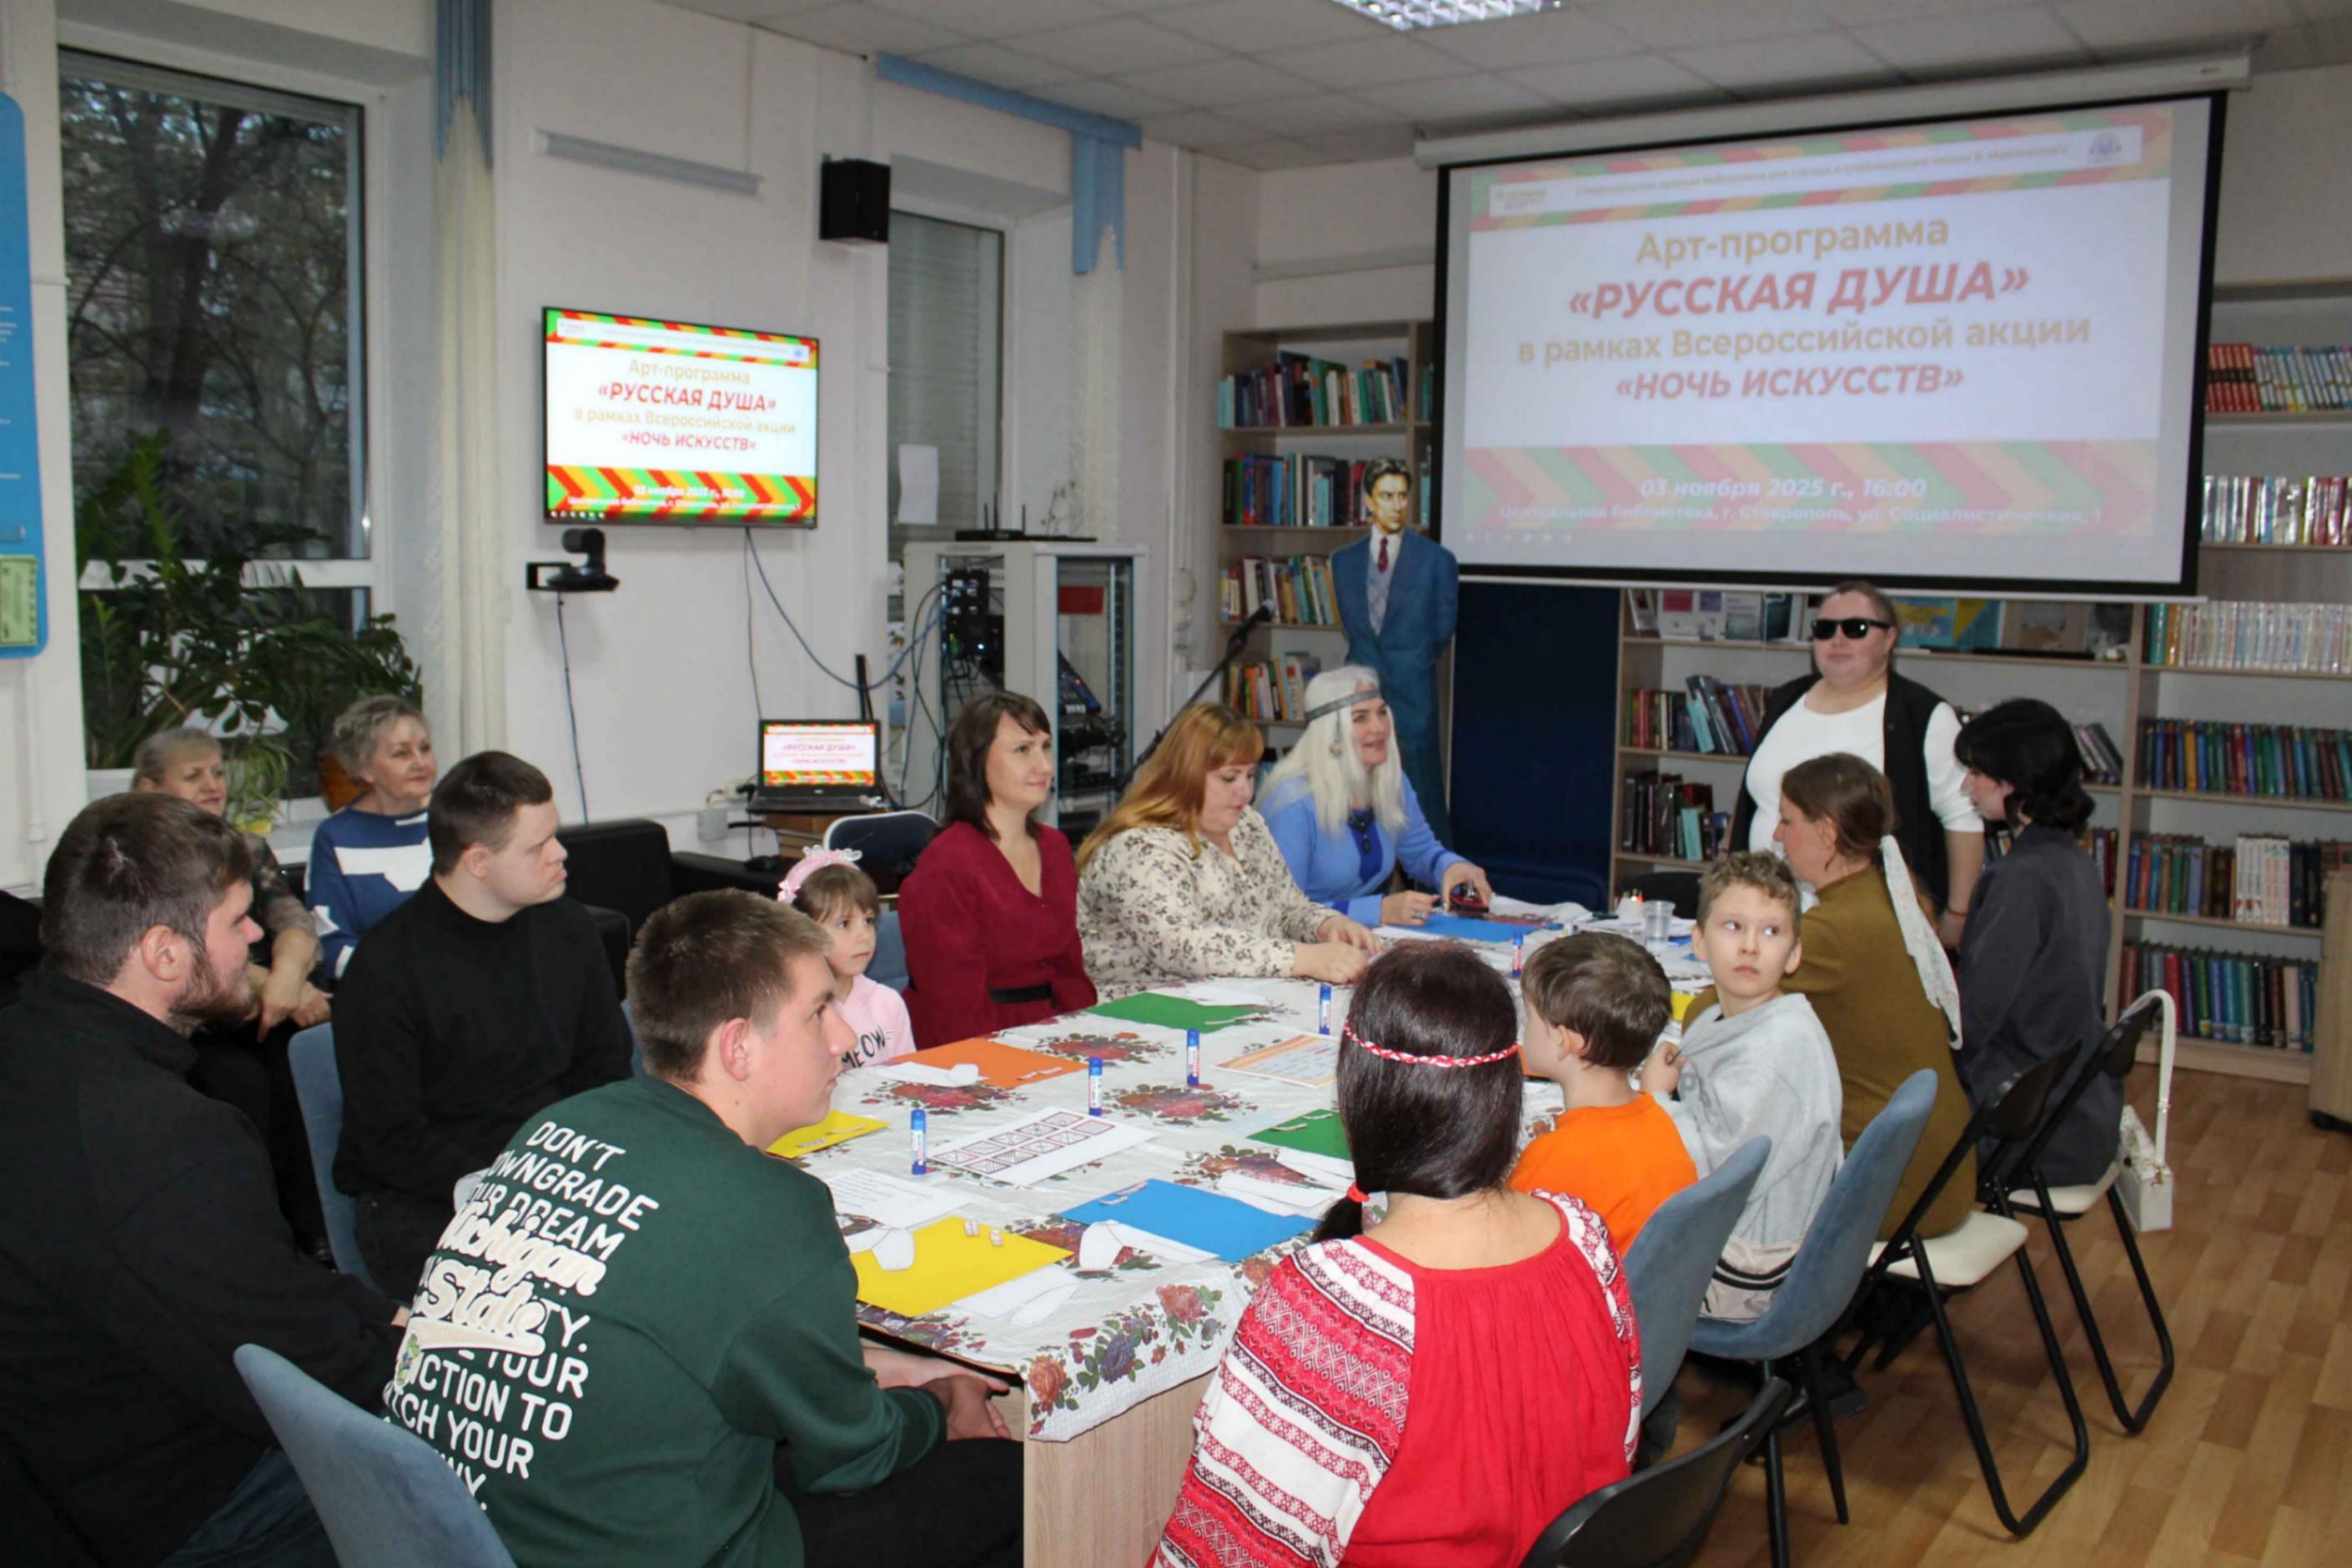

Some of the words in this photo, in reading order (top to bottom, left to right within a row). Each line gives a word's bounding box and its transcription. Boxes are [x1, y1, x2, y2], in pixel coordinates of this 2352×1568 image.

[1636, 218, 1950, 269] Арт-программа
[1569, 271, 1817, 319] «РУССКАЯ
[1827, 261, 2030, 315] ДУША»
[1517, 342, 1535, 364] в
[1545, 334, 1662, 369] рамках
[1671, 317, 1954, 361] Всероссийской
[1966, 318, 2092, 353] акции
[628, 359, 751, 385] Арт-программа
[1616, 370, 1732, 401] «НОЧЬ
[1741, 364, 1964, 397] ИСКУССТВ»
[598, 381, 703, 407] «РУССКАЯ
[707, 393, 776, 412] ДУША»
[587, 409, 641, 424] рамках
[645, 410, 752, 432] Всероссийской
[756, 421, 796, 435] акции
[621, 430, 671, 447] «НОЧЬ
[675, 433, 756, 452] ИСКУССТВ»
[1641, 478, 1666, 498] 03
[1674, 478, 1761, 500] ноября
[1767, 478, 1824, 498] 2025
[1862, 478, 1927, 498] 16:00
[841, 1026, 887, 1068] MEOW
[526, 1121, 626, 1172] DON'T
[487, 1148, 660, 1231] OWNGRADE
[520, 1392, 573, 1440] TO
[447, 1410, 534, 1480] YOUR
